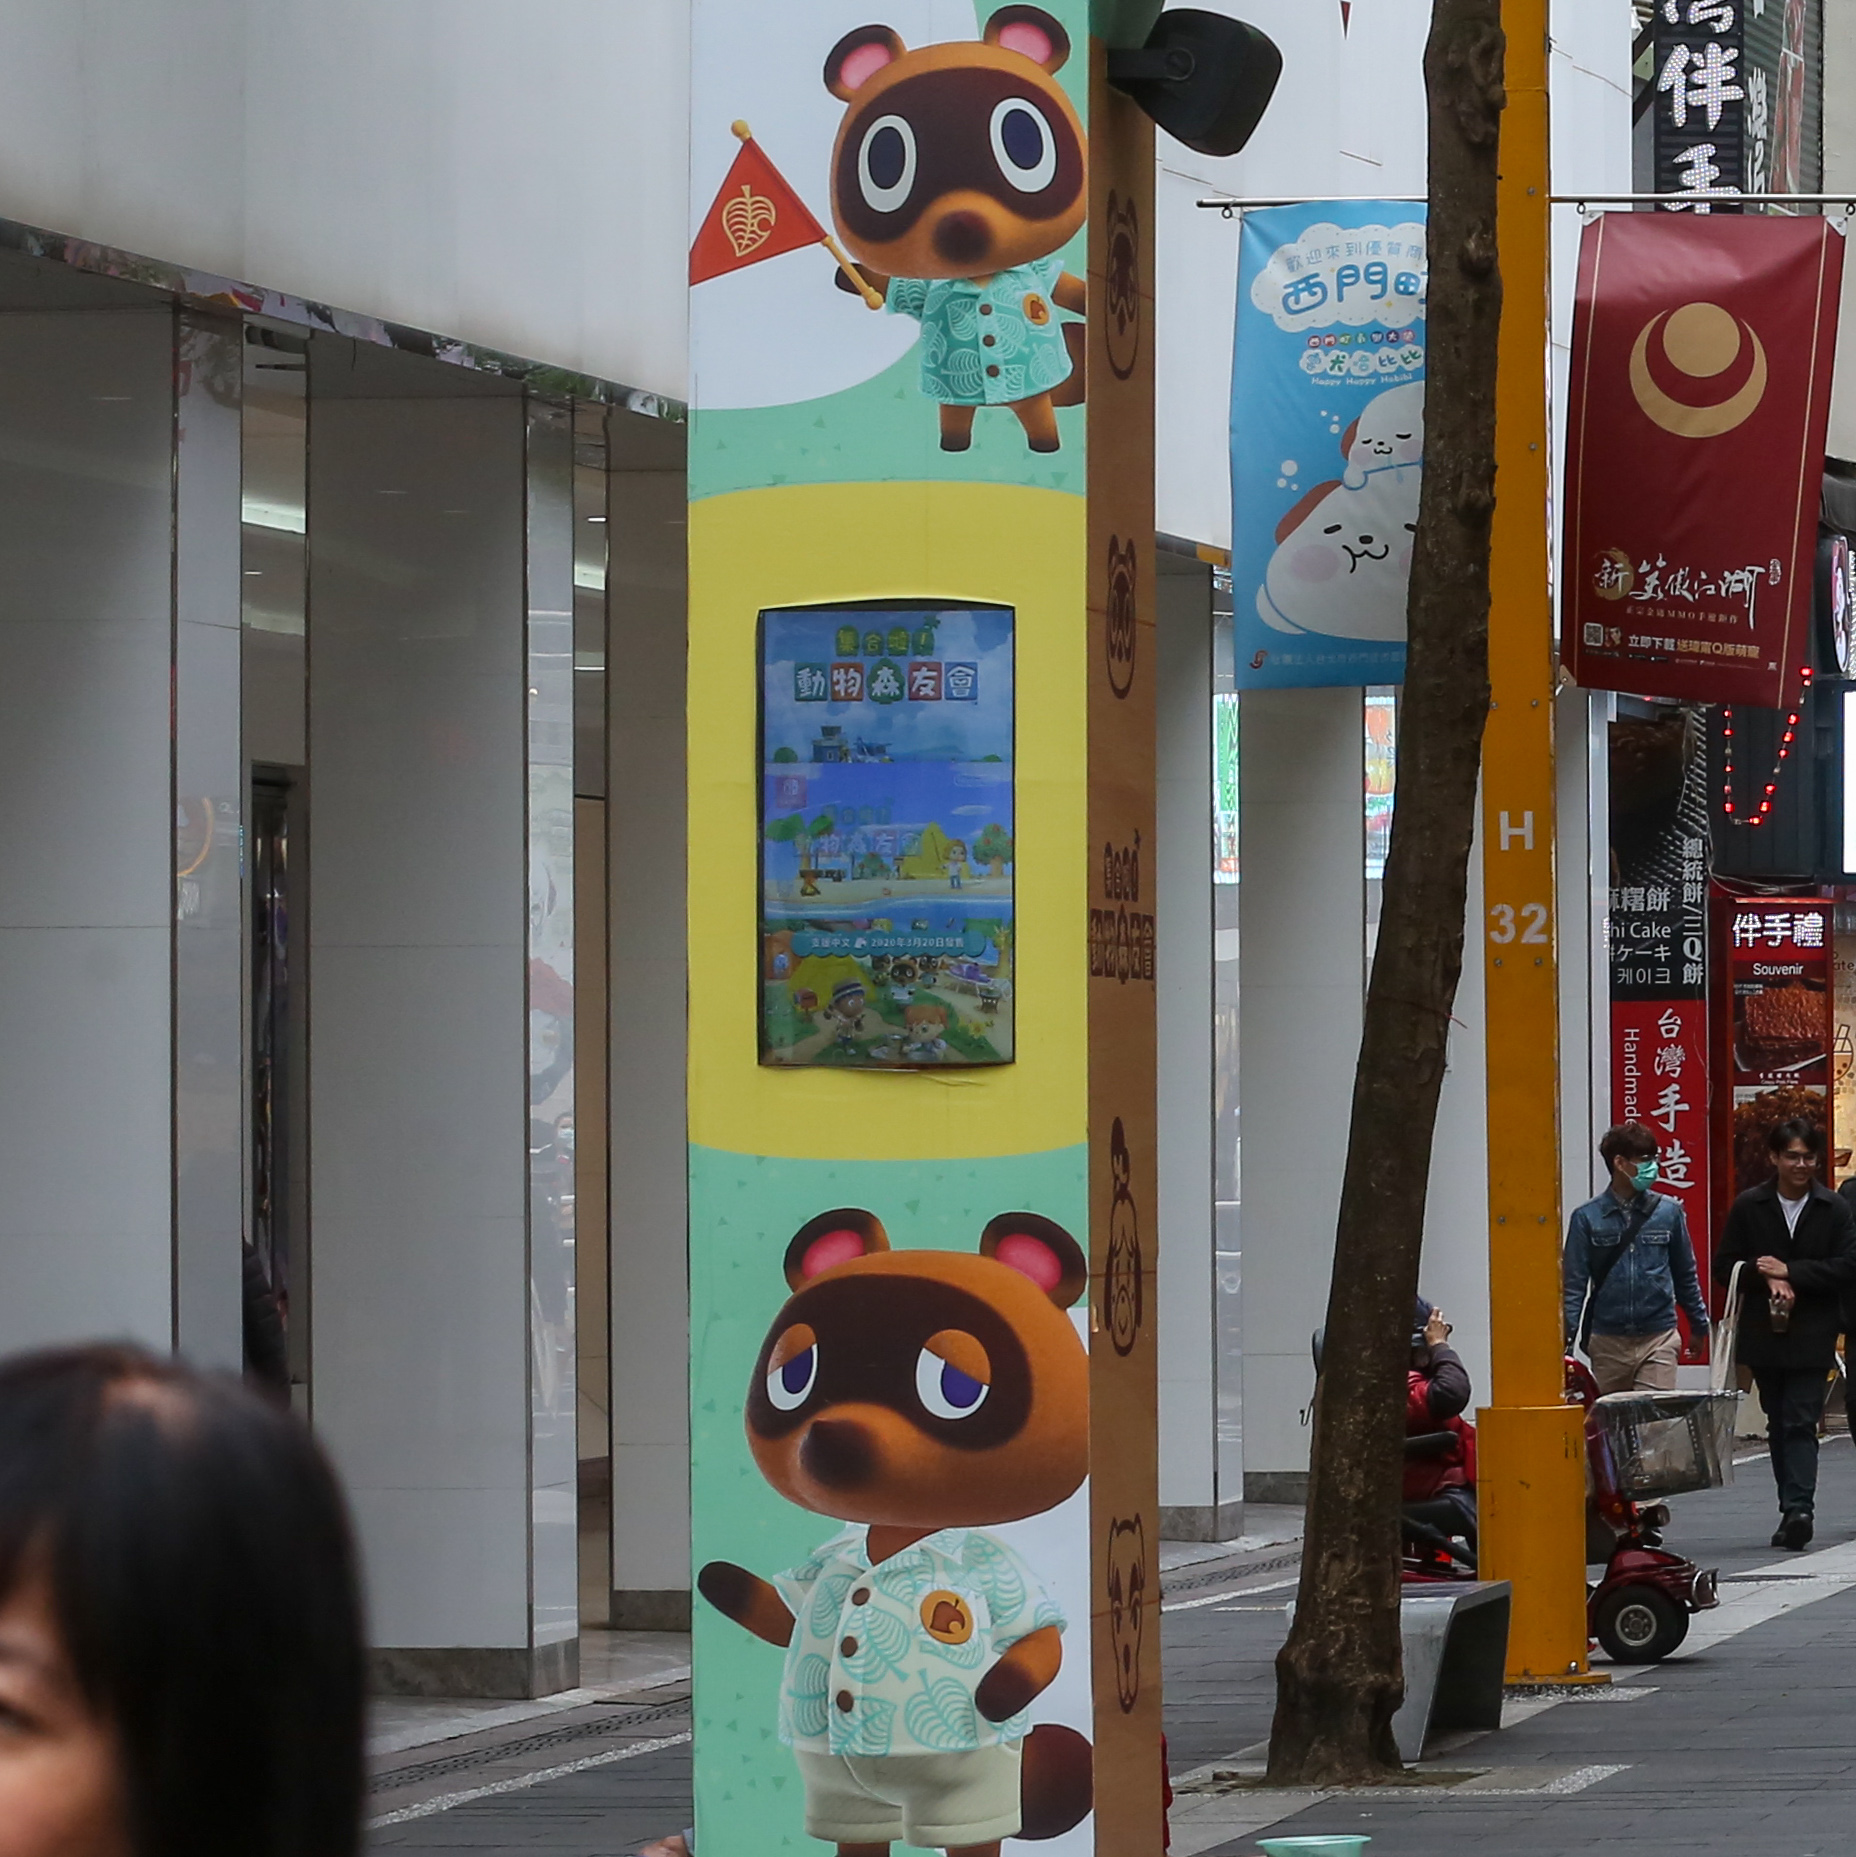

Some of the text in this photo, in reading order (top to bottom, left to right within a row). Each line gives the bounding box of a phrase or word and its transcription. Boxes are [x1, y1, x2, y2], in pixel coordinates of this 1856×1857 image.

[1285, 239, 1427, 274] 歡迎來到優質商
[795, 664, 977, 699] 動物森友會
[1500, 811, 1534, 850] H
[1489, 903, 1548, 945] 32
[1630, 921, 1672, 939] Cake
[1731, 911, 1826, 948] 伴手禮
[1752, 962, 1804, 977] Souvenir
